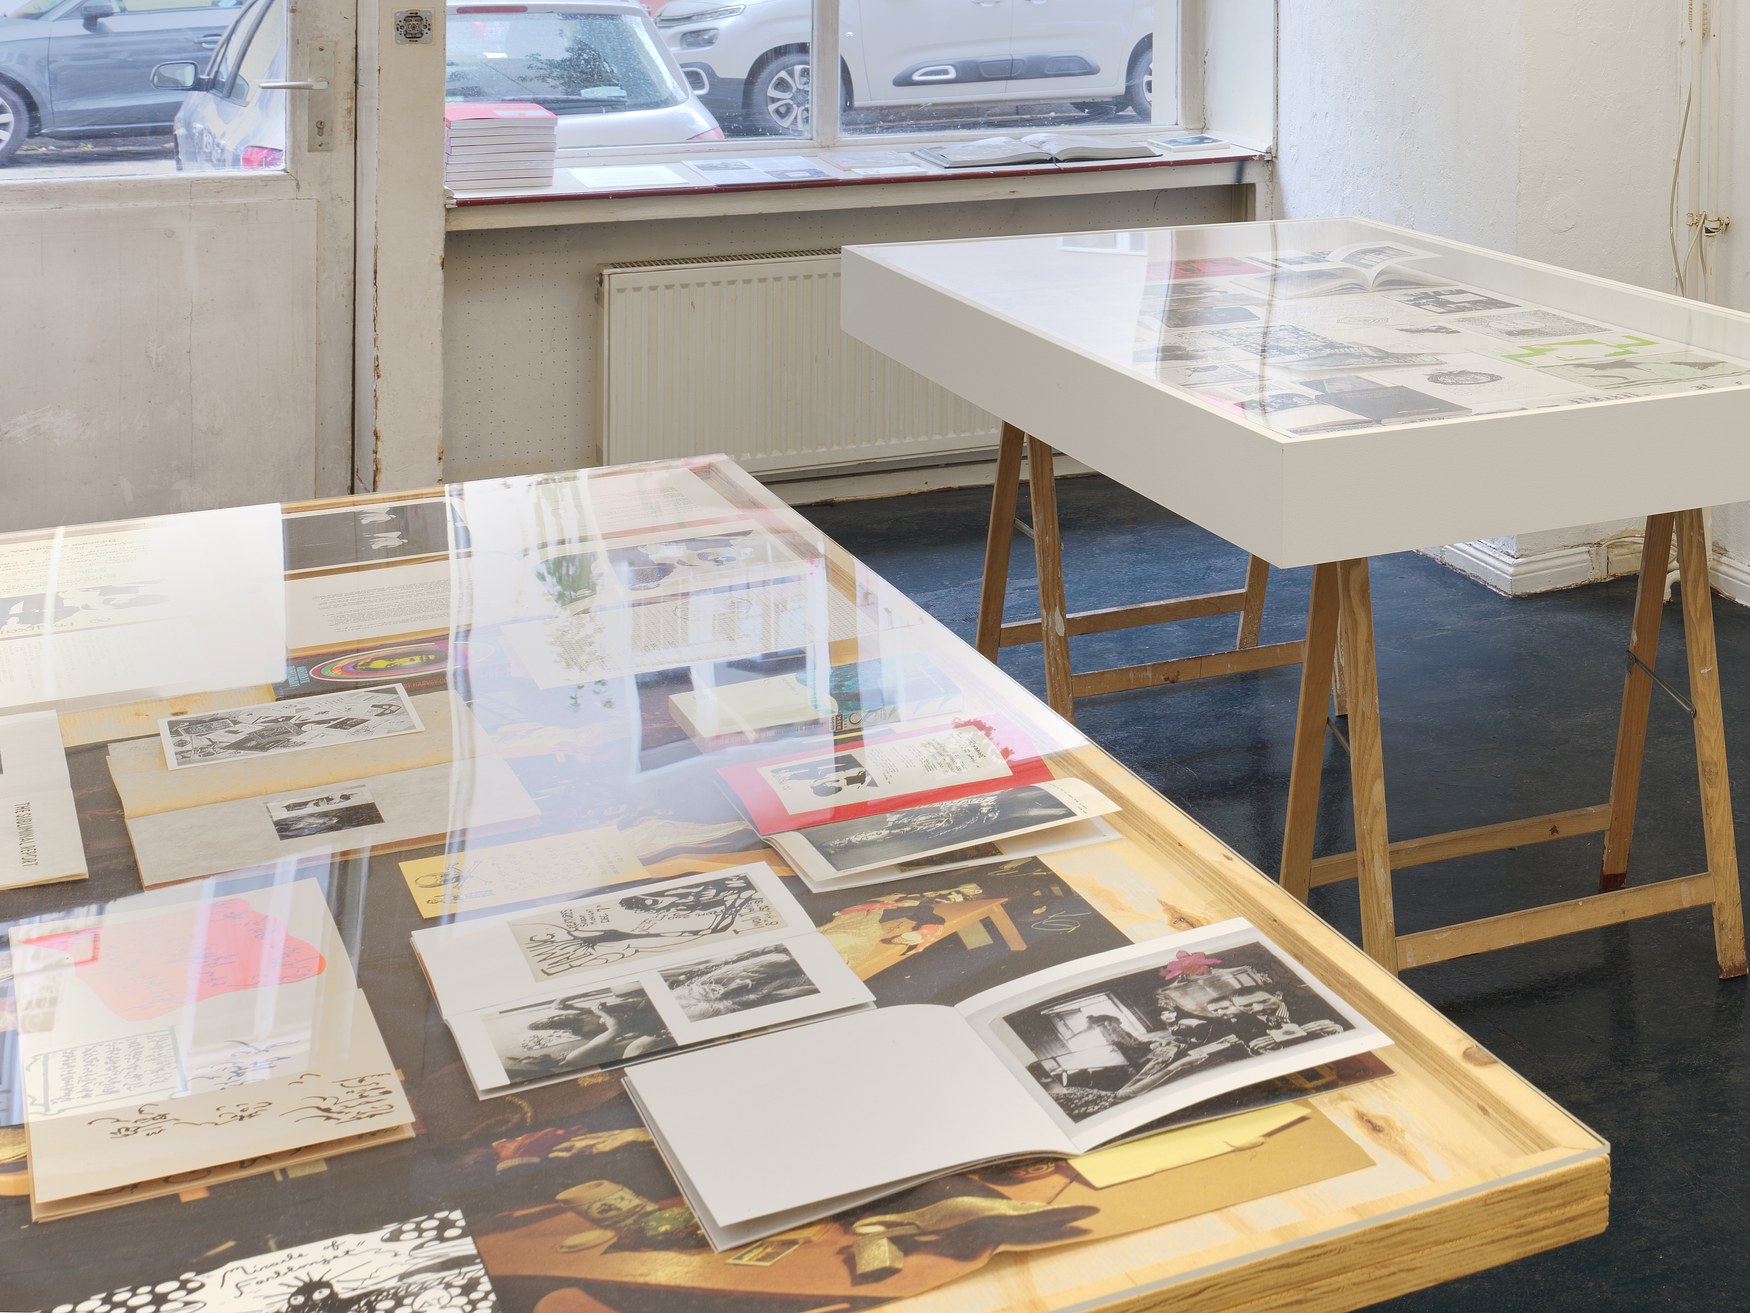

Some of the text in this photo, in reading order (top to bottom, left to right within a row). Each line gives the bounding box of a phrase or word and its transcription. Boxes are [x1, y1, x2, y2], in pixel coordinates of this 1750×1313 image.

[14, 801, 31, 814] THE
[20, 844, 39, 868] REPORT
[323, 1240, 346, 1252] of
